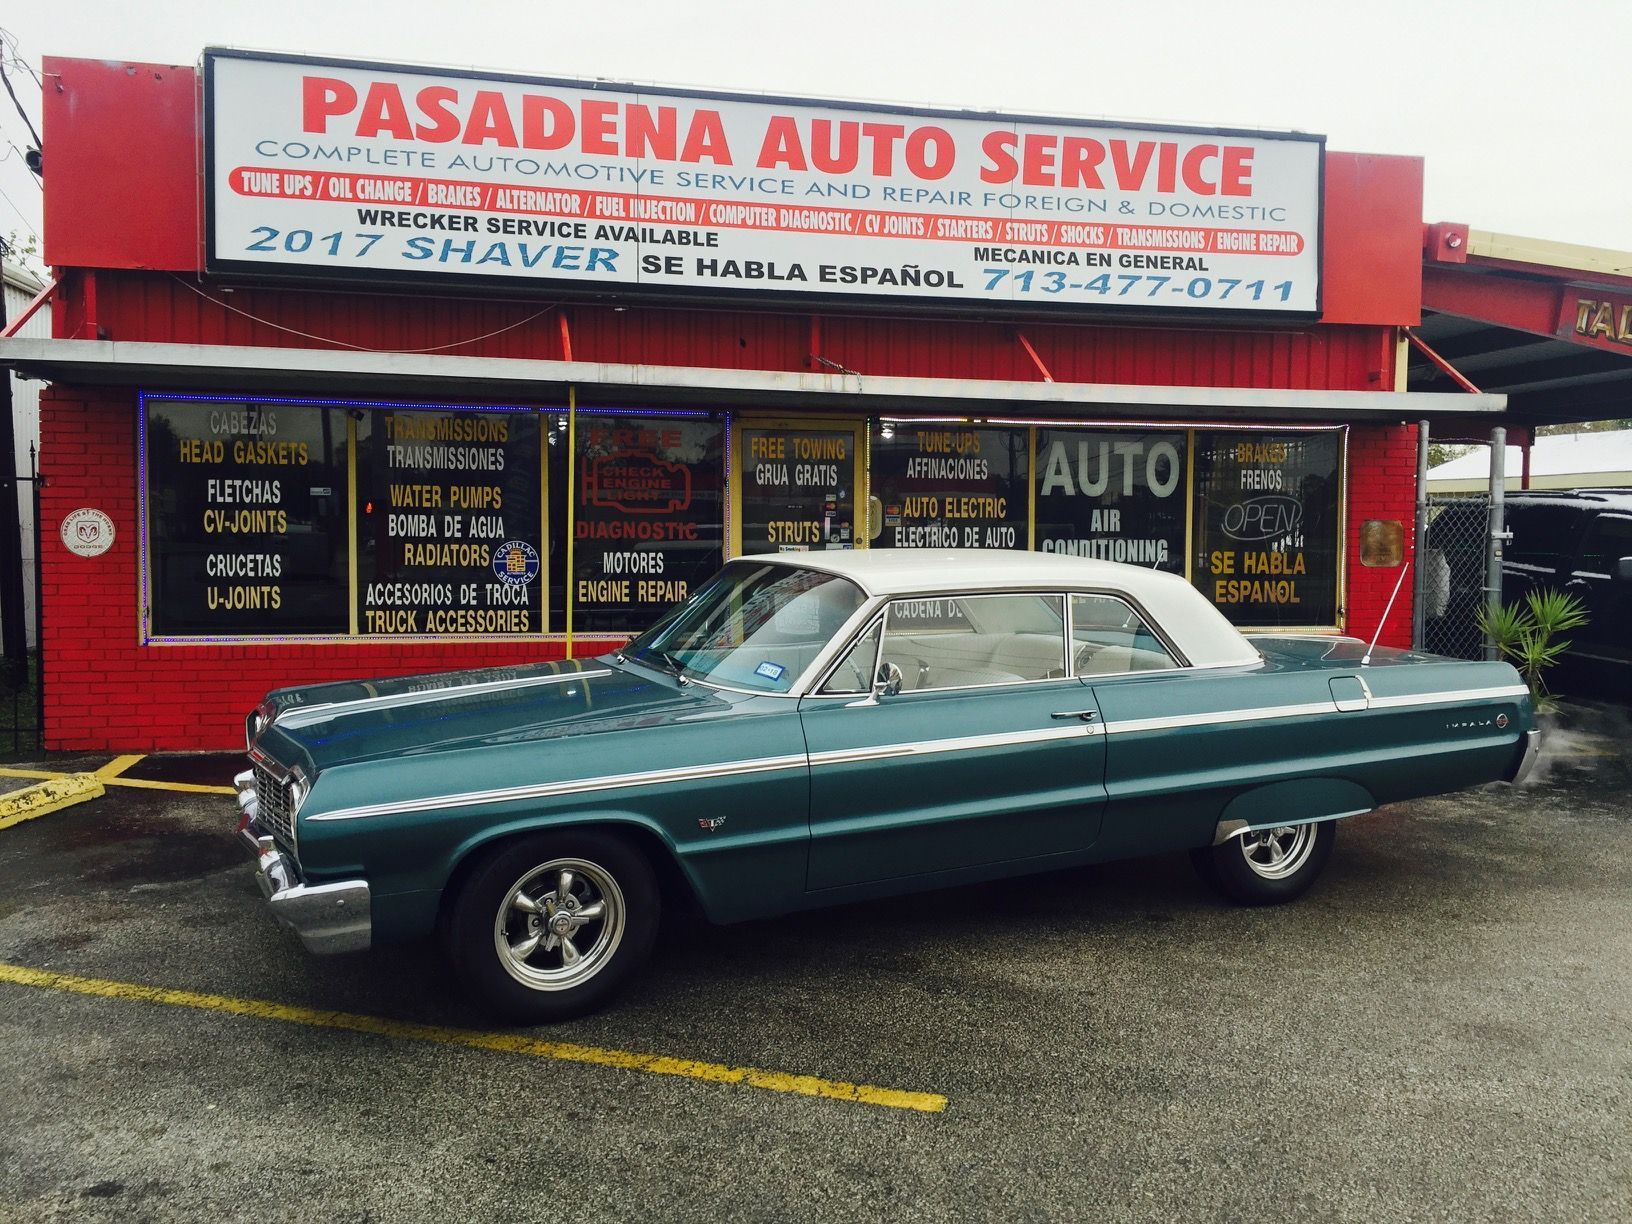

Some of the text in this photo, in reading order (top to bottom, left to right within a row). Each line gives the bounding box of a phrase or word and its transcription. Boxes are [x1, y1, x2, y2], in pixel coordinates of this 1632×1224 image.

[302, 76, 1254, 197] PASADENA AUTO SERVICE
[255, 139, 1287, 223] COMPLETE AUTOMOTIVE SERVICE AND REPAIR FOREIGN & DOMESTIC
[241, 171, 279, 194] TUNE
[284, 173, 312, 197] UPS
[328, 176, 352, 199] OIL
[356, 178, 412, 202] CHANGE
[427, 184, 481, 208] BRAKES
[496, 188, 581, 214] ALTERNATOR
[595, 196, 625, 218] FUEL
[629, 198, 695, 222] INJECTION
[709, 204, 776, 227] COMPUTER
[780, 209, 852, 232] DIAGNOSTIC
[865, 214, 880, 233] CV
[883, 215, 924, 236] JOINTS
[937, 218, 993, 240] STARTERS
[1005, 222, 1049, 243] STRUTS
[1061, 225, 1104, 245] SHOCKS
[1117, 228, 1205, 250] TRANSMISSIONS
[1217, 232, 1256, 251] ENGINE
[1259, 233, 1299, 253] REPAIR
[357, 208, 719, 248] WRECKER SERVICE AVAILABLE
[246, 225, 620, 273] 2017 SHAVER
[974, 247, 1209, 272] MECANICA EN GENERAL
[641, 254, 964, 289] SE HABLA ESPAÑOL
[982, 268, 1293, 302] 713-477-0711
[210, 410, 277, 435] CABEZAS
[385, 416, 509, 442] TRANSMISSIONS
[591, 428, 682, 448] FREE
[751, 437, 845, 460] FREE TOWING
[917, 432, 981, 453] TUNE-UPS
[180, 440, 309, 466] HEAD GASKETS
[387, 445, 505, 471] TRANSMISSIONES
[1237, 443, 1287, 463] BRAKES
[602, 467, 664, 477] CHECK
[756, 463, 838, 487] GRUA GRATIS
[907, 458, 988, 480] AFFINACIONES
[1041, 440, 1180, 498] AUTO
[1241, 470, 1282, 490] FRENOS
[208, 479, 281, 504] FLETCHAS
[602, 479, 672, 489] ENGINE
[390, 484, 502, 510] WATER PUMPS
[903, 497, 1006, 519] AUTO ELECTRIC
[70, 512, 81, 522] LIFE
[204, 510, 287, 534] CV-JOINTS
[388, 514, 505, 539] BOMBA DE AGUA
[1090, 509, 1121, 532] AIR
[1225, 504, 1296, 532] OPEN
[576, 520, 699, 540] DIAGNOSTIC
[768, 521, 820, 543] STRUTS
[895, 526, 1016, 548] ELECTRICO DE AUTO
[404, 543, 490, 568] RADIATORS
[496, 542, 536, 558] CADILLAC
[1042, 539, 1168, 563] CONDITIONING
[206, 554, 282, 577] CRUCETAS
[603, 552, 664, 574] MOTORES
[1210, 551, 1306, 575] SE HABLA
[498, 571, 534, 585] SERVICE
[207, 586, 281, 610] U-JOINTS
[366, 583, 529, 606] ACCESORIOS DE TROCA
[578, 580, 688, 603] ENGINE REPAIR
[1215, 580, 1300, 603] ESPANOL
[894, 600, 942, 619] CADENA
[365, 610, 529, 633] TRUCK ACCESSORIES
